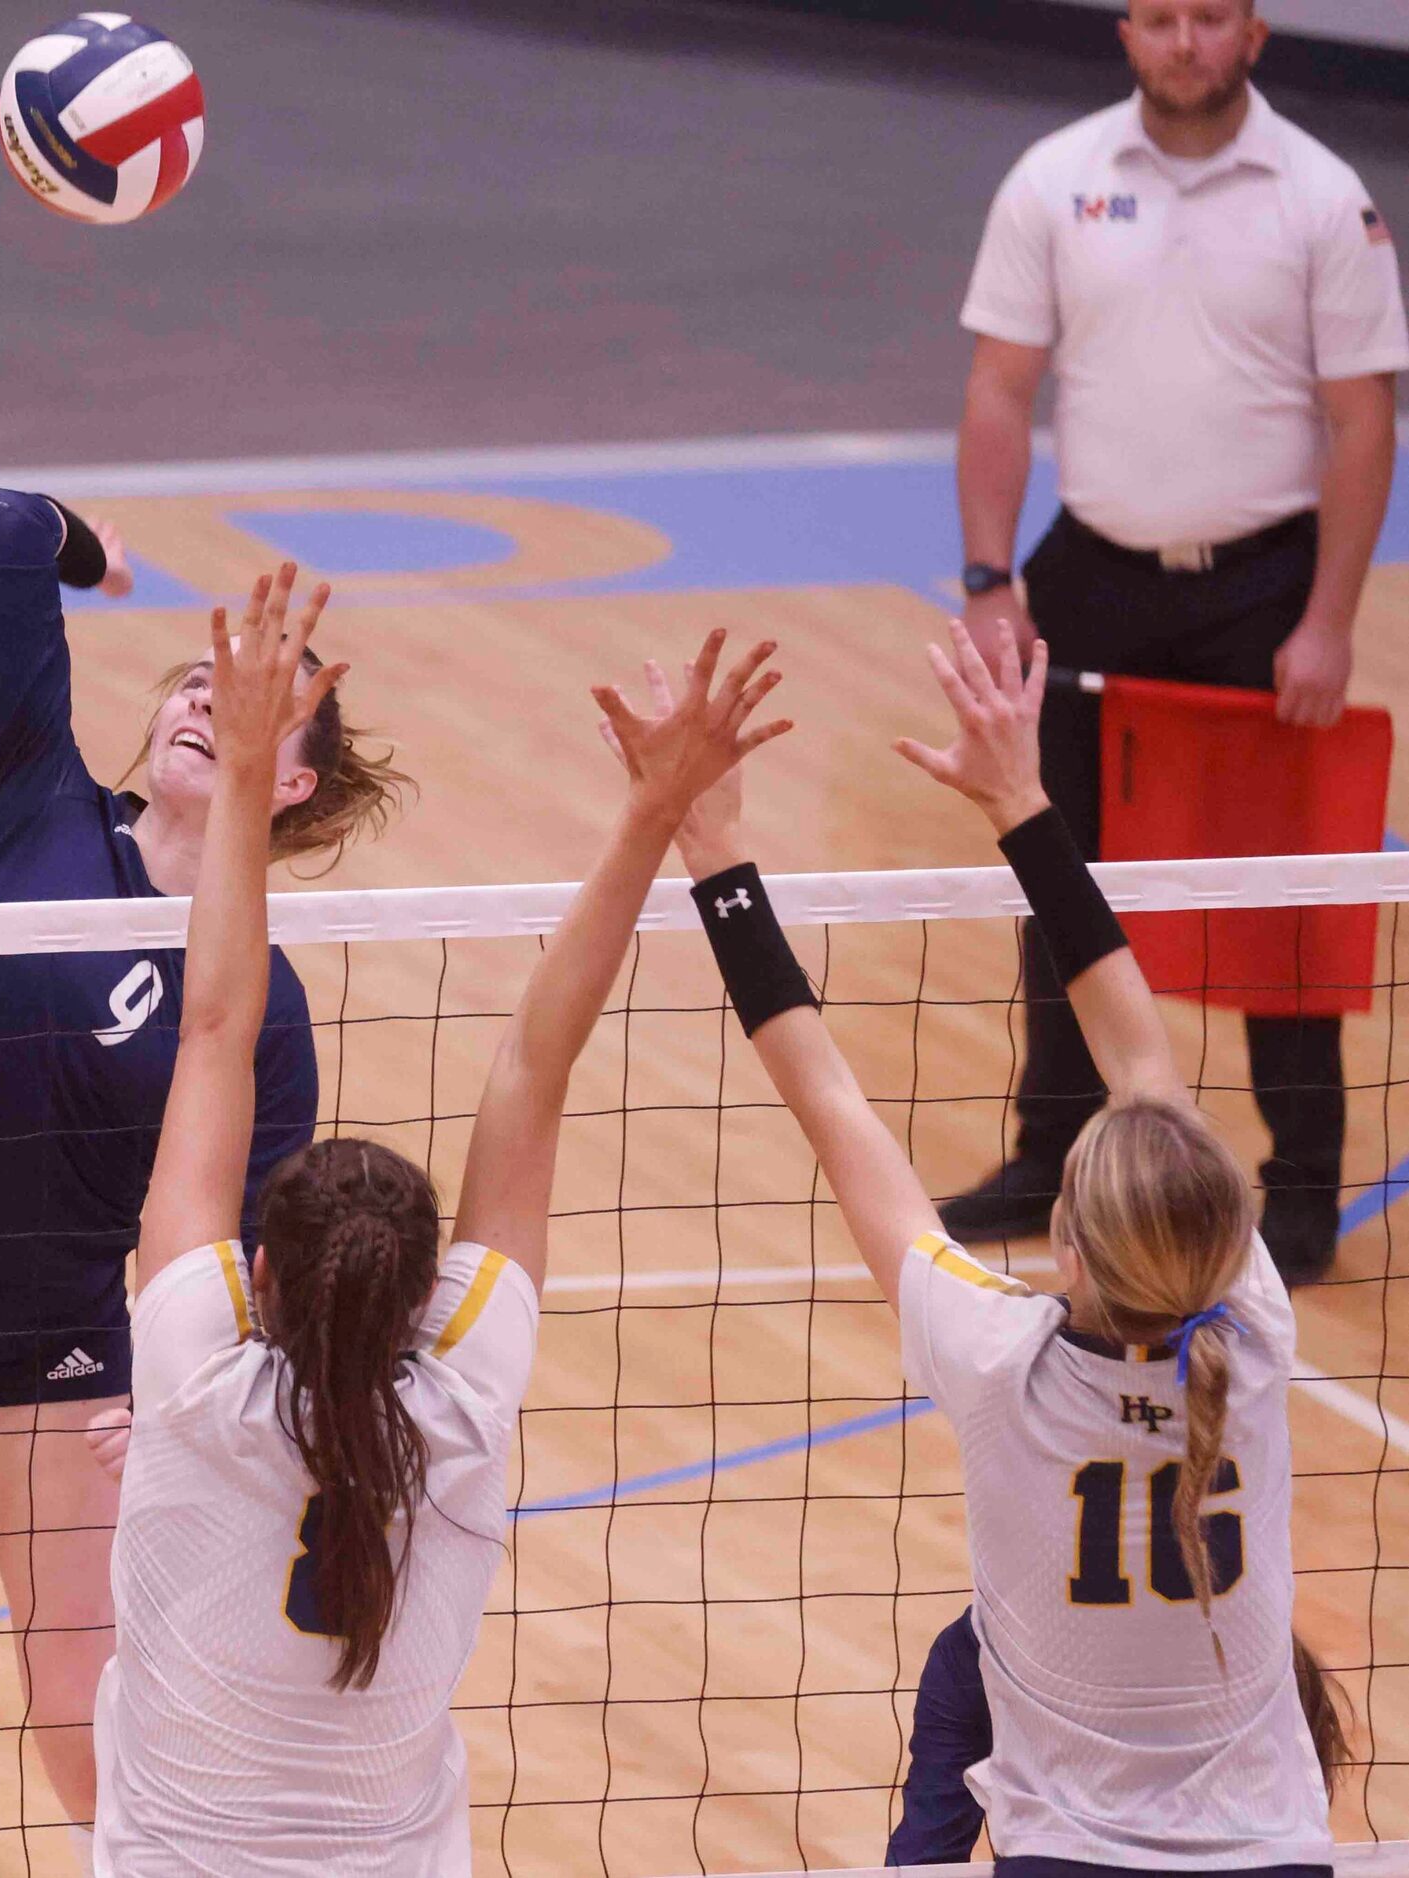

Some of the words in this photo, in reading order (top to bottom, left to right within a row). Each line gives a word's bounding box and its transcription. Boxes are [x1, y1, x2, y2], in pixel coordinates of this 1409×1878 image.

[91, 959, 164, 1047] 9
[46, 1361, 105, 1380] adidas
[1119, 1394, 1175, 1432] HP
[1066, 1454, 1246, 1607] 16
